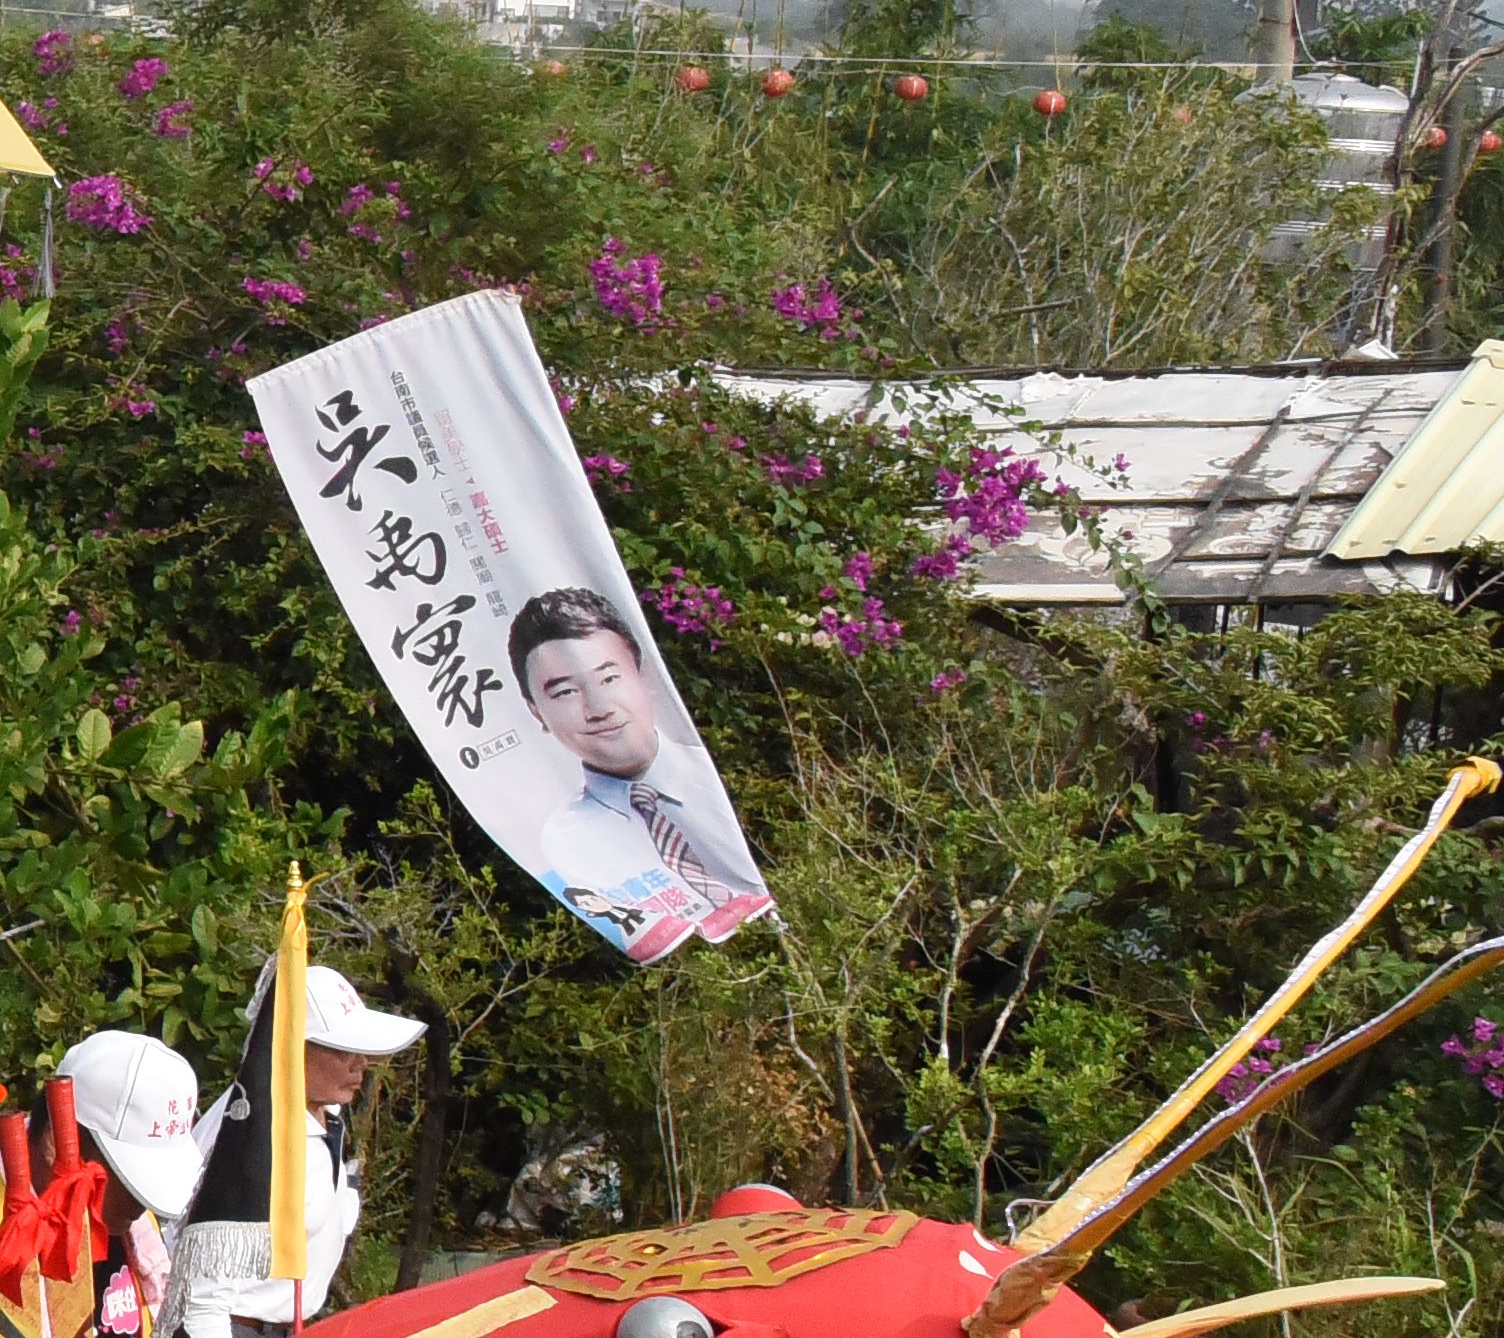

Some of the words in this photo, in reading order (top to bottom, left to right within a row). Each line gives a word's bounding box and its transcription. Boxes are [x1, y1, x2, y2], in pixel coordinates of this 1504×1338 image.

[390, 370, 447, 481] 台南市議員候選人
